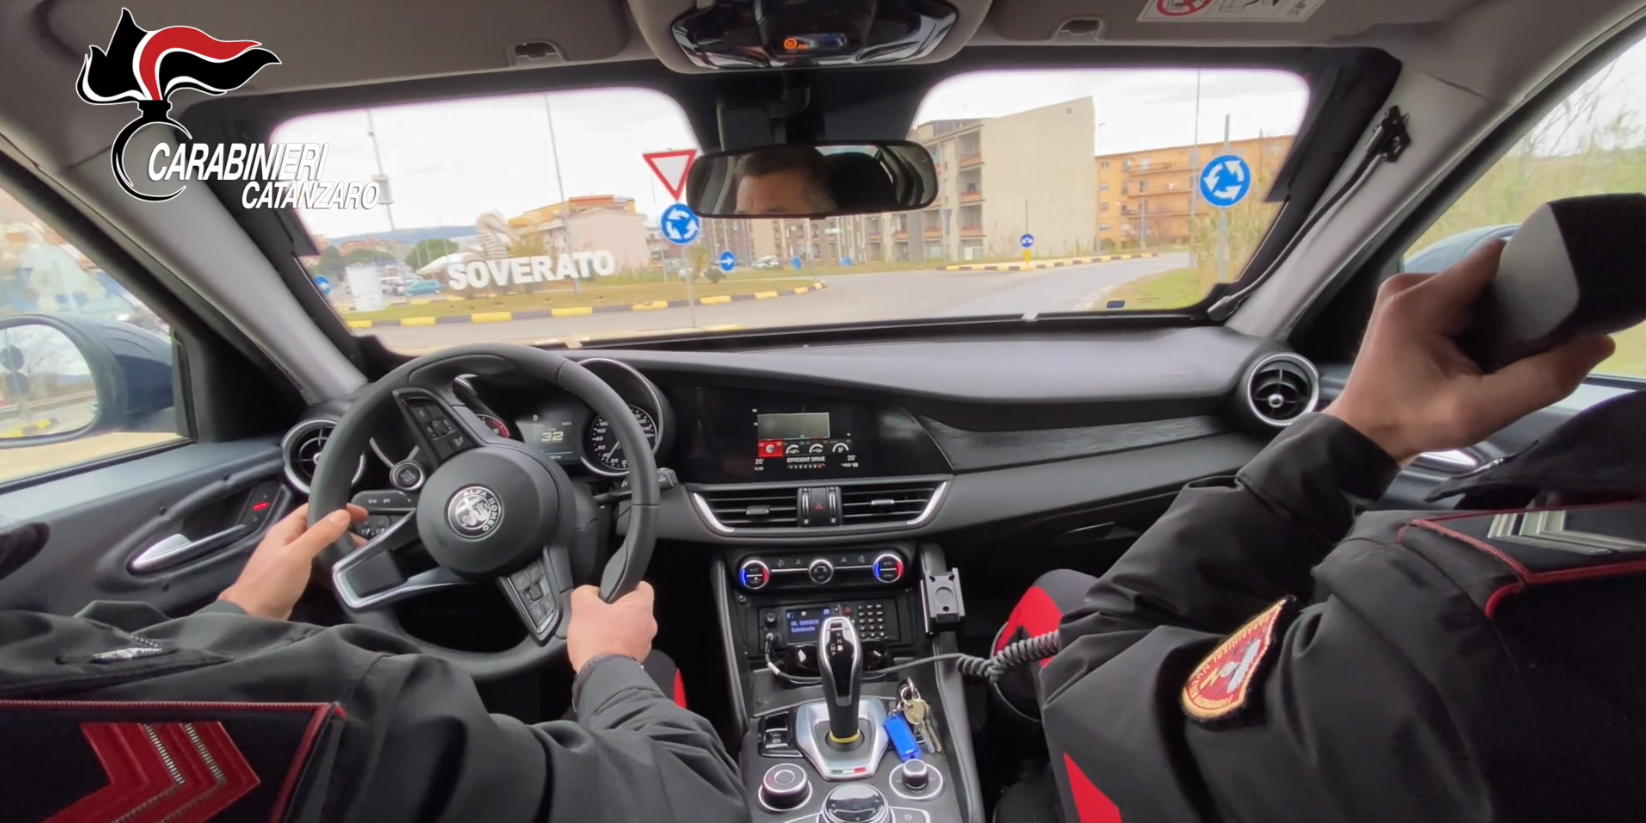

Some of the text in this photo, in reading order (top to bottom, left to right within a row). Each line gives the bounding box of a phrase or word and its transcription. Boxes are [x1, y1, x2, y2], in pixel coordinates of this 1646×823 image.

[448, 250, 616, 290] SOVERATO
[541, 431, 564, 442] 32
[464, 489, 498, 532] ALFA ROMEO
